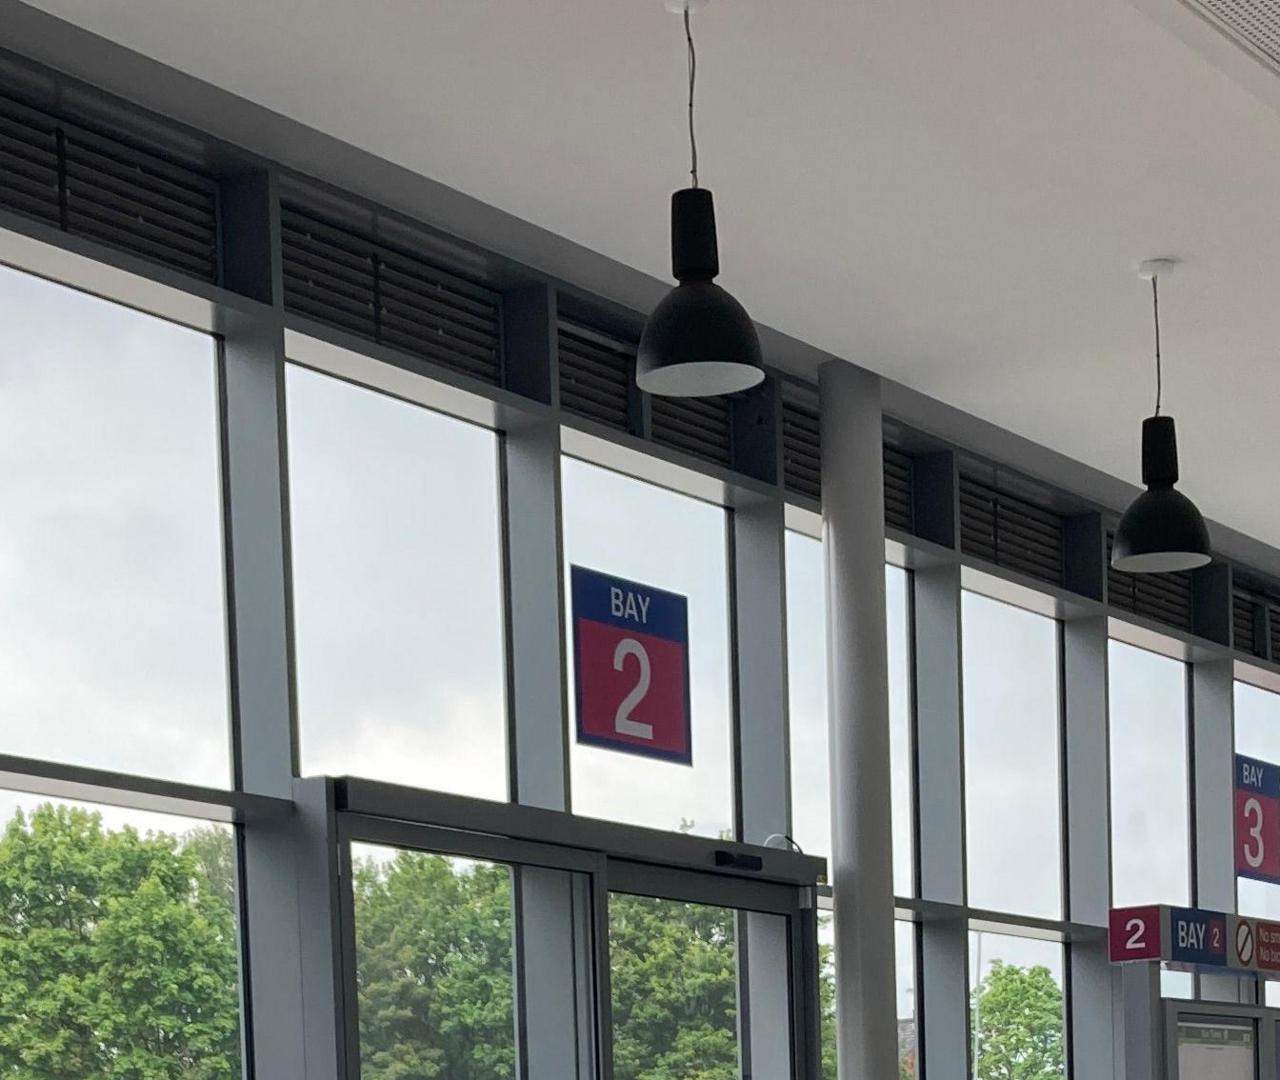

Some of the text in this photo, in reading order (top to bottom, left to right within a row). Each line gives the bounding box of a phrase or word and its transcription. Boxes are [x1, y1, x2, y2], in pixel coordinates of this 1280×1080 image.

[610, 586, 651, 624] BAY
[613, 638, 654, 740] 2
[1242, 764, 1264, 788] BAY
[1243, 797, 1265, 868] 3
[1125, 918, 1146, 950] 2
[1178, 920, 1220, 950] BAY 2
